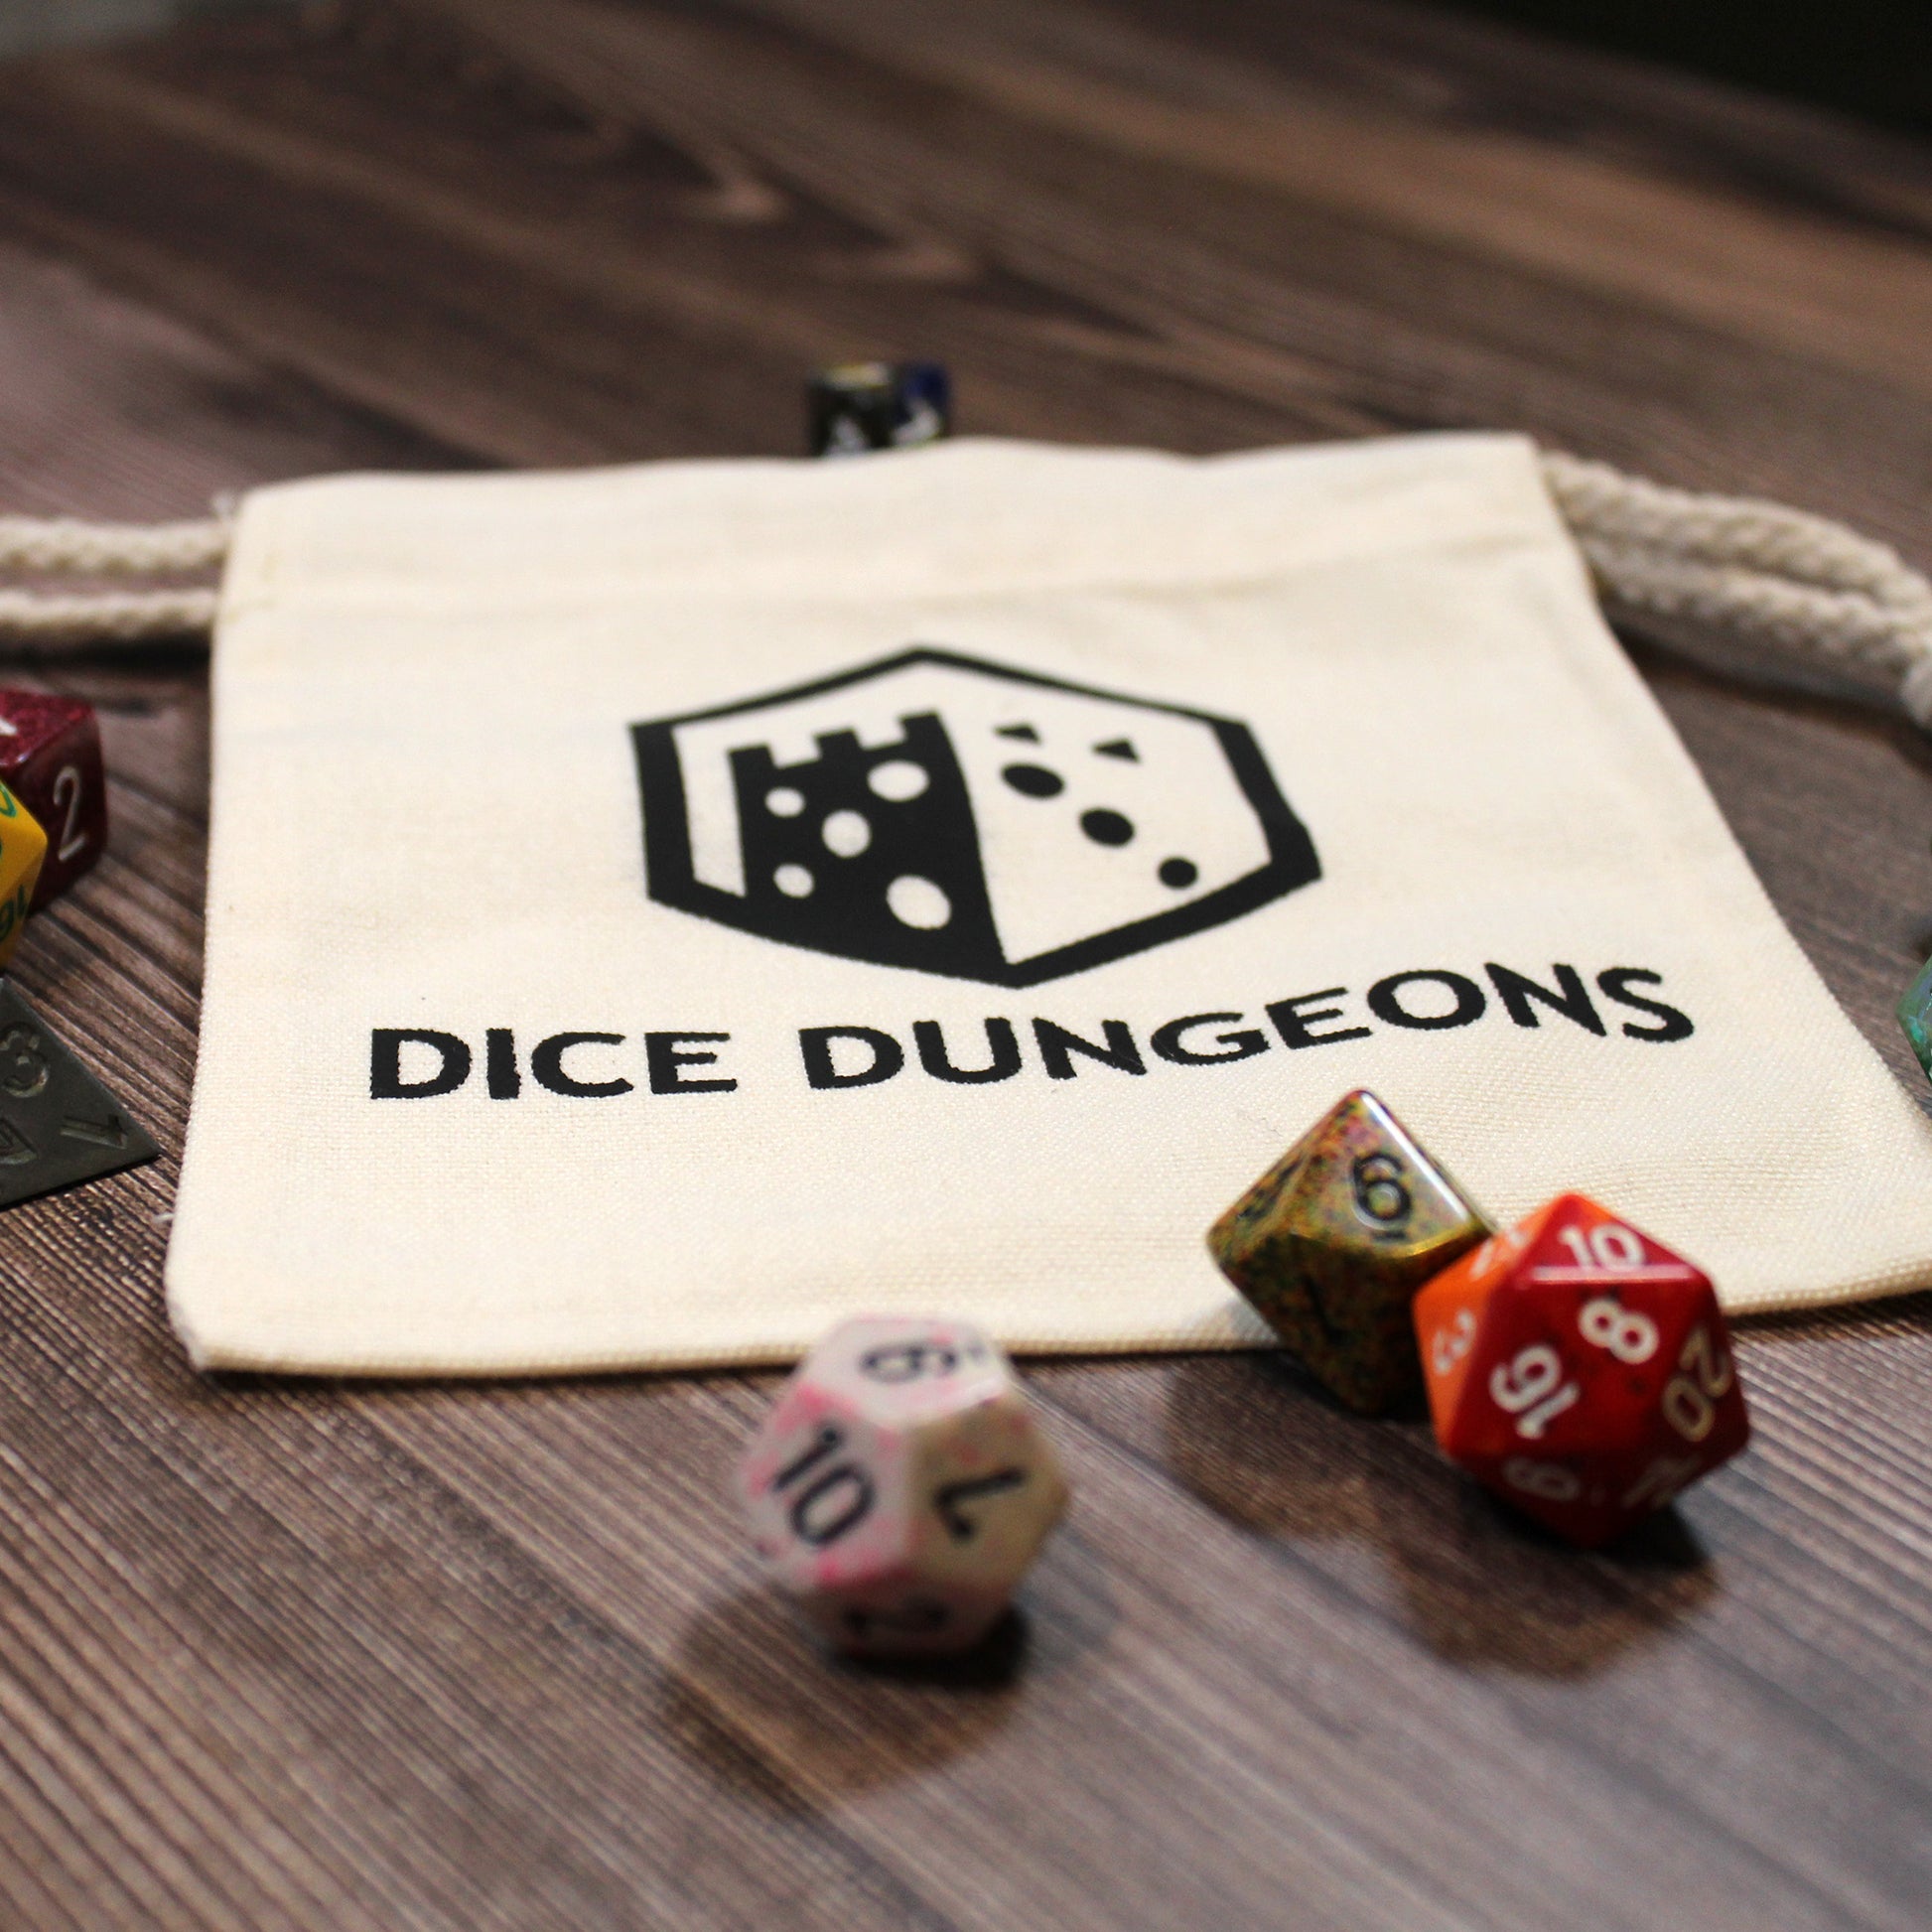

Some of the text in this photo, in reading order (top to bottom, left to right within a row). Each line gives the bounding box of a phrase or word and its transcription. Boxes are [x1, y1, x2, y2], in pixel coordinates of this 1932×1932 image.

[53, 764, 86, 862] 2
[368, 962, 1695, 1101] DICE DUNGEONS
[1351, 1153, 1413, 1223] 6
[1558, 1222, 1646, 1273] 10
[1578, 1298, 1660, 1365] 8
[1489, 1342, 1582, 1441] 16
[1662, 1322, 1734, 1444] 20
[770, 1425, 879, 1549] 10
